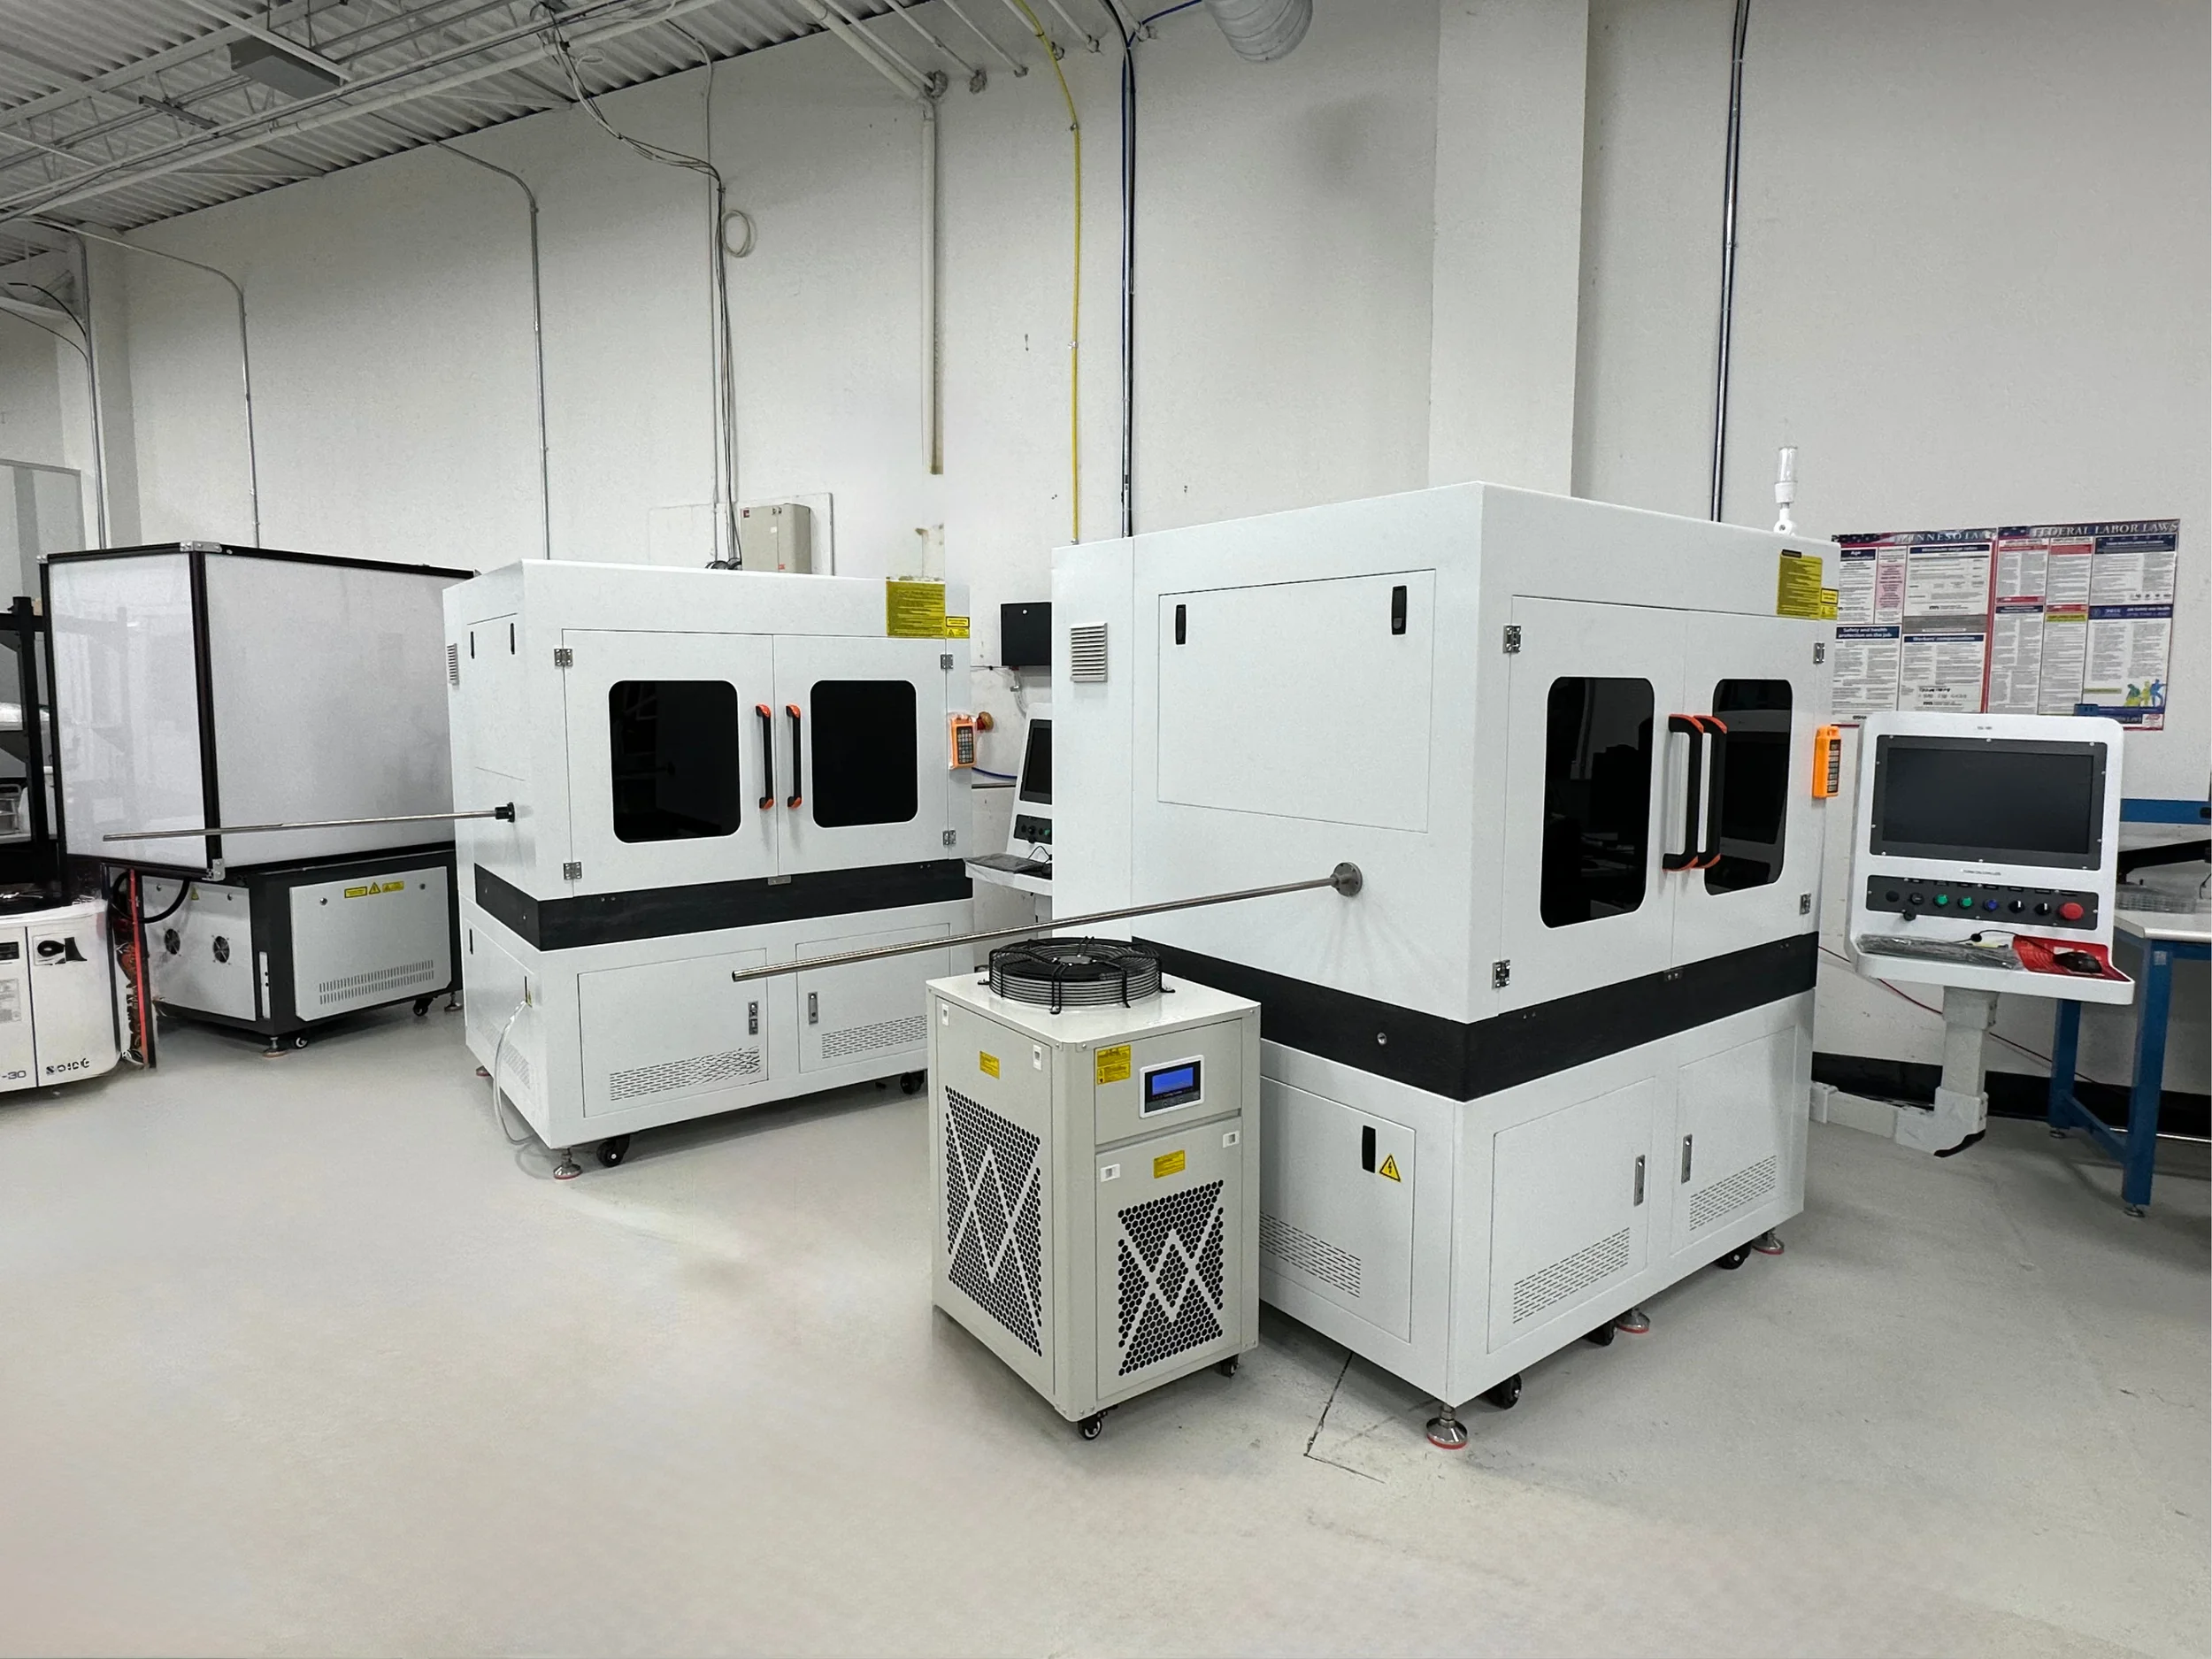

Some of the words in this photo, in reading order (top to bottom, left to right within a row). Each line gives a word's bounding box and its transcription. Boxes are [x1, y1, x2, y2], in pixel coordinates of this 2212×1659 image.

[2035, 526, 2088, 537] FEDERAL
[2095, 524, 2138, 534] LABOR
[2143, 522, 2177, 533] LAWS
[1, 1070, 27, 1079] -30
